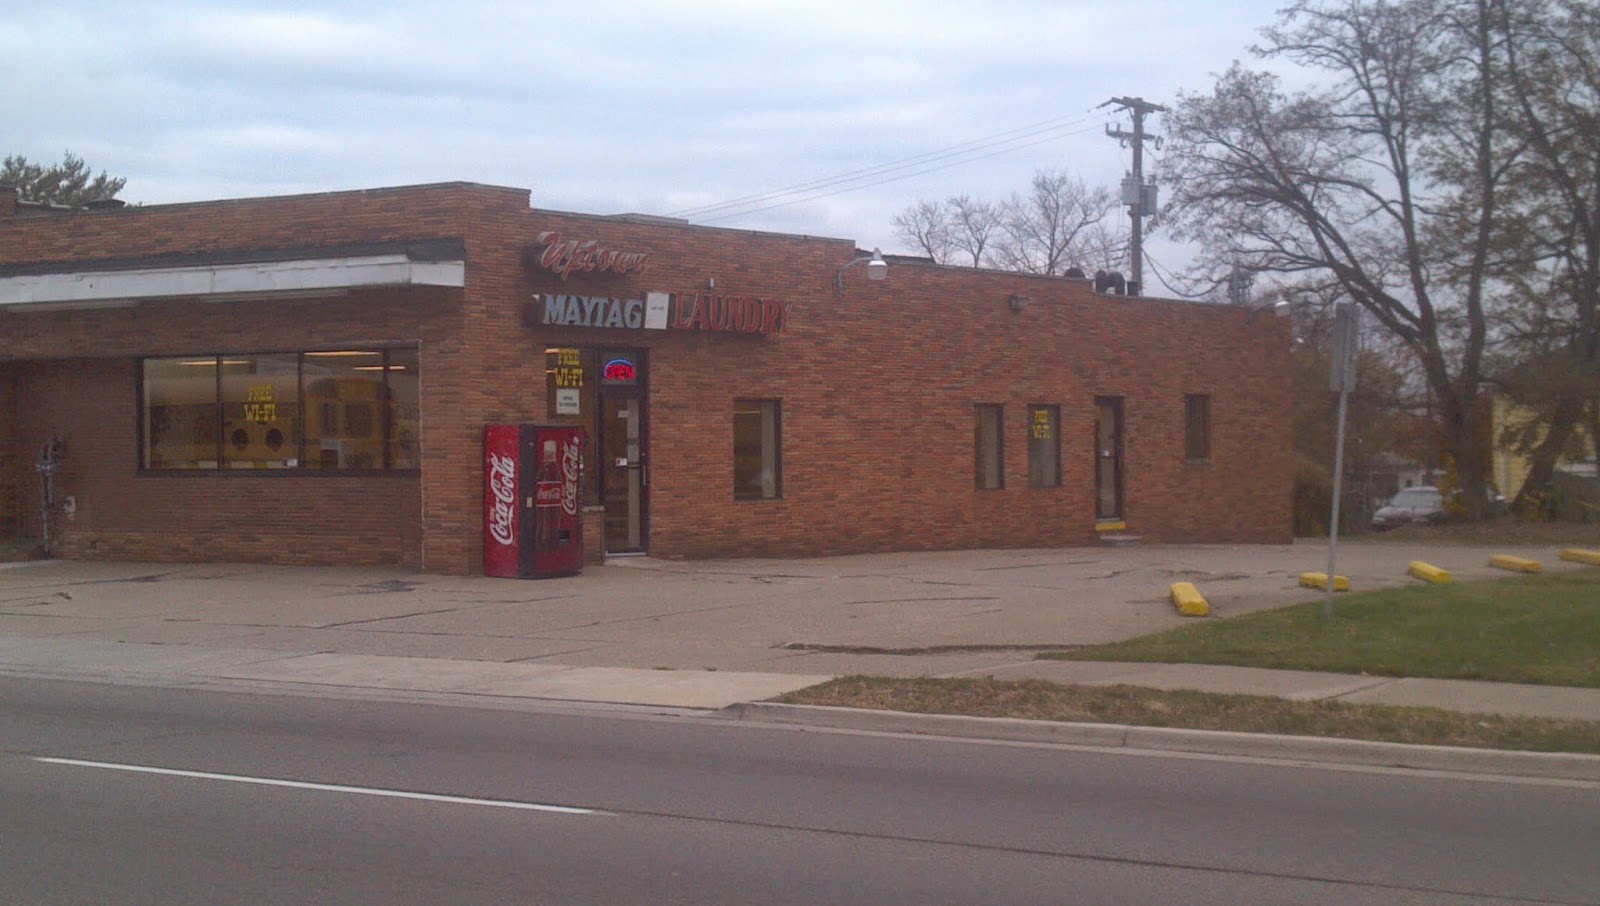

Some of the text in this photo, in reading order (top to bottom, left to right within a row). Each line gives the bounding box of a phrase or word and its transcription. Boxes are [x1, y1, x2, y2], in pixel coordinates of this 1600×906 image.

[537, 231, 649, 281] Uptown
[542, 291, 792, 334] MAYTAG LAUNDRY
[558, 348, 580, 366] FREE
[554, 368, 584, 387] WI-FI
[605, 363, 635, 381] OPEN
[248, 385, 273, 401] FREE
[243, 403, 276, 422] WI-FI
